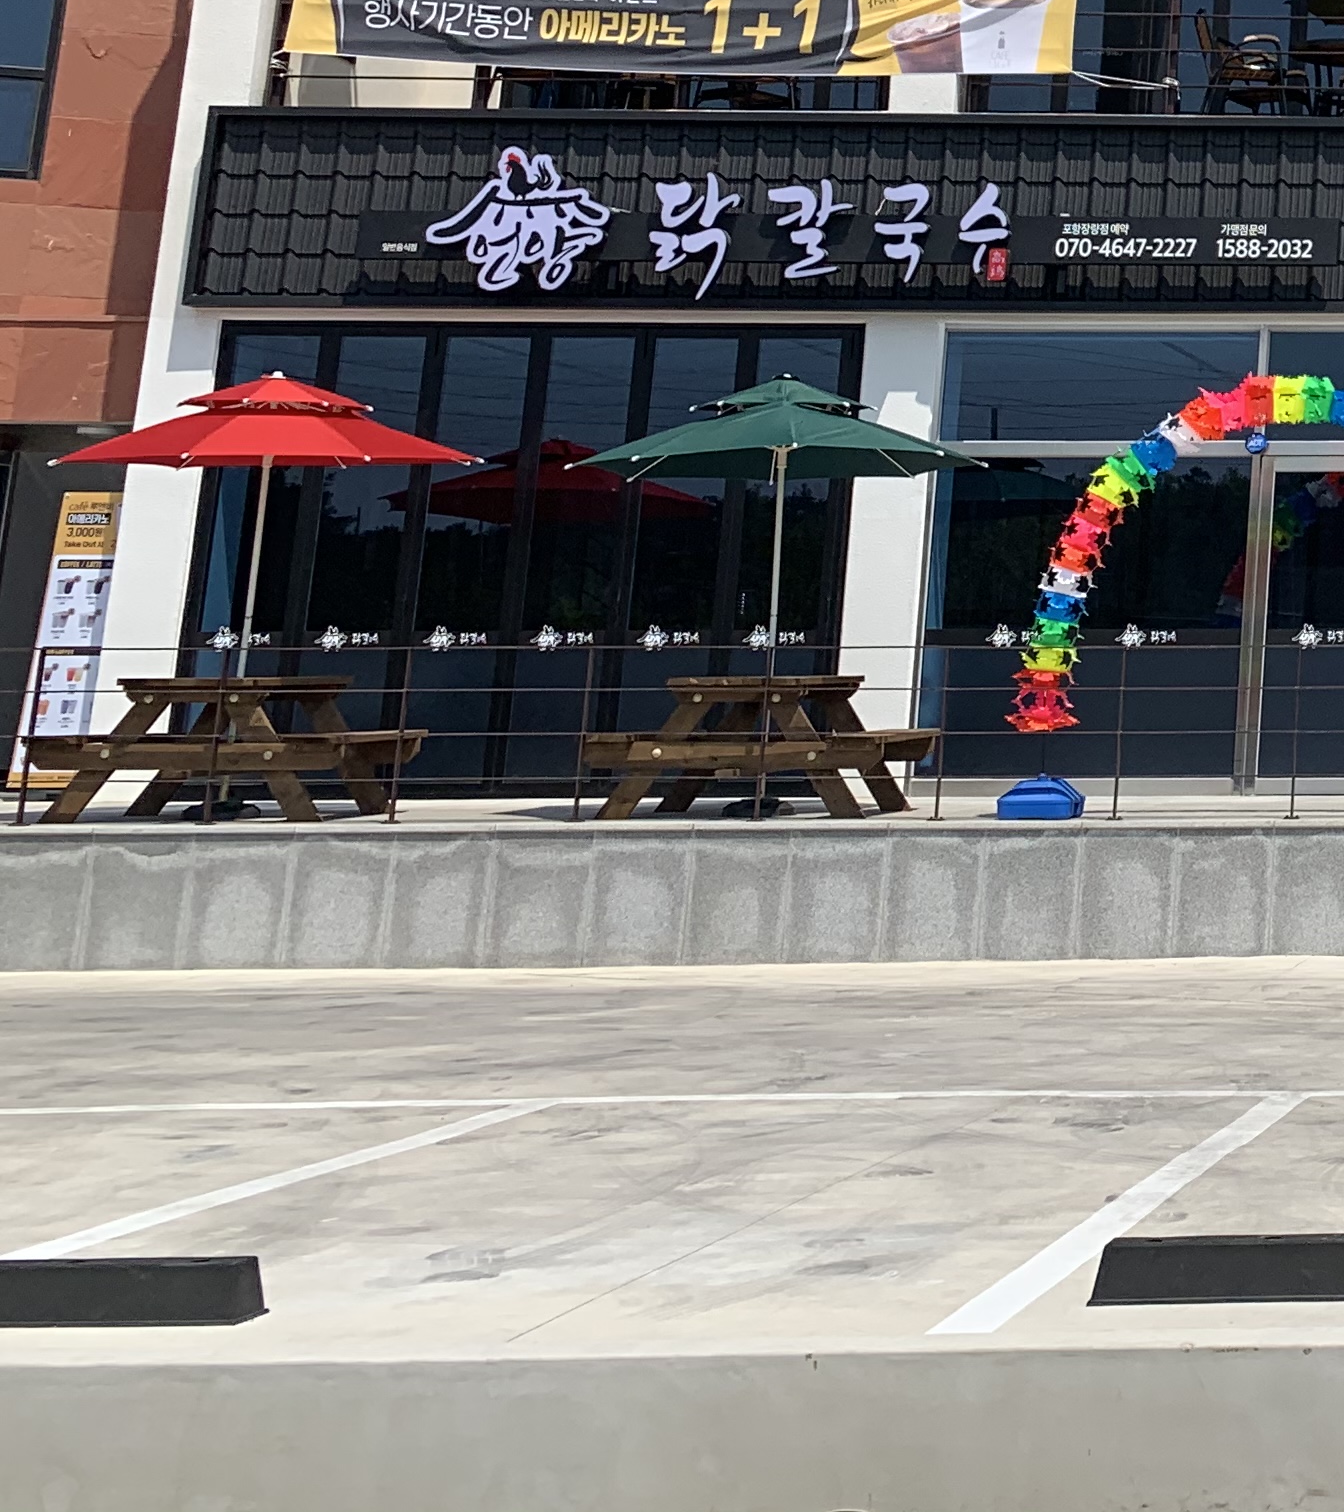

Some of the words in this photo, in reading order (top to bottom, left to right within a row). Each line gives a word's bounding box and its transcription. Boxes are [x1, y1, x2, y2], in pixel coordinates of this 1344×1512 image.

[539, 7, 686, 46] 아메리카노
[1061, 223, 1109, 236] 포항장량점
[1110, 223, 1130, 236] 예약
[1054, 238, 1198, 258] 070-4647-2227
[1216, 239, 1313, 259] 1588-2032
